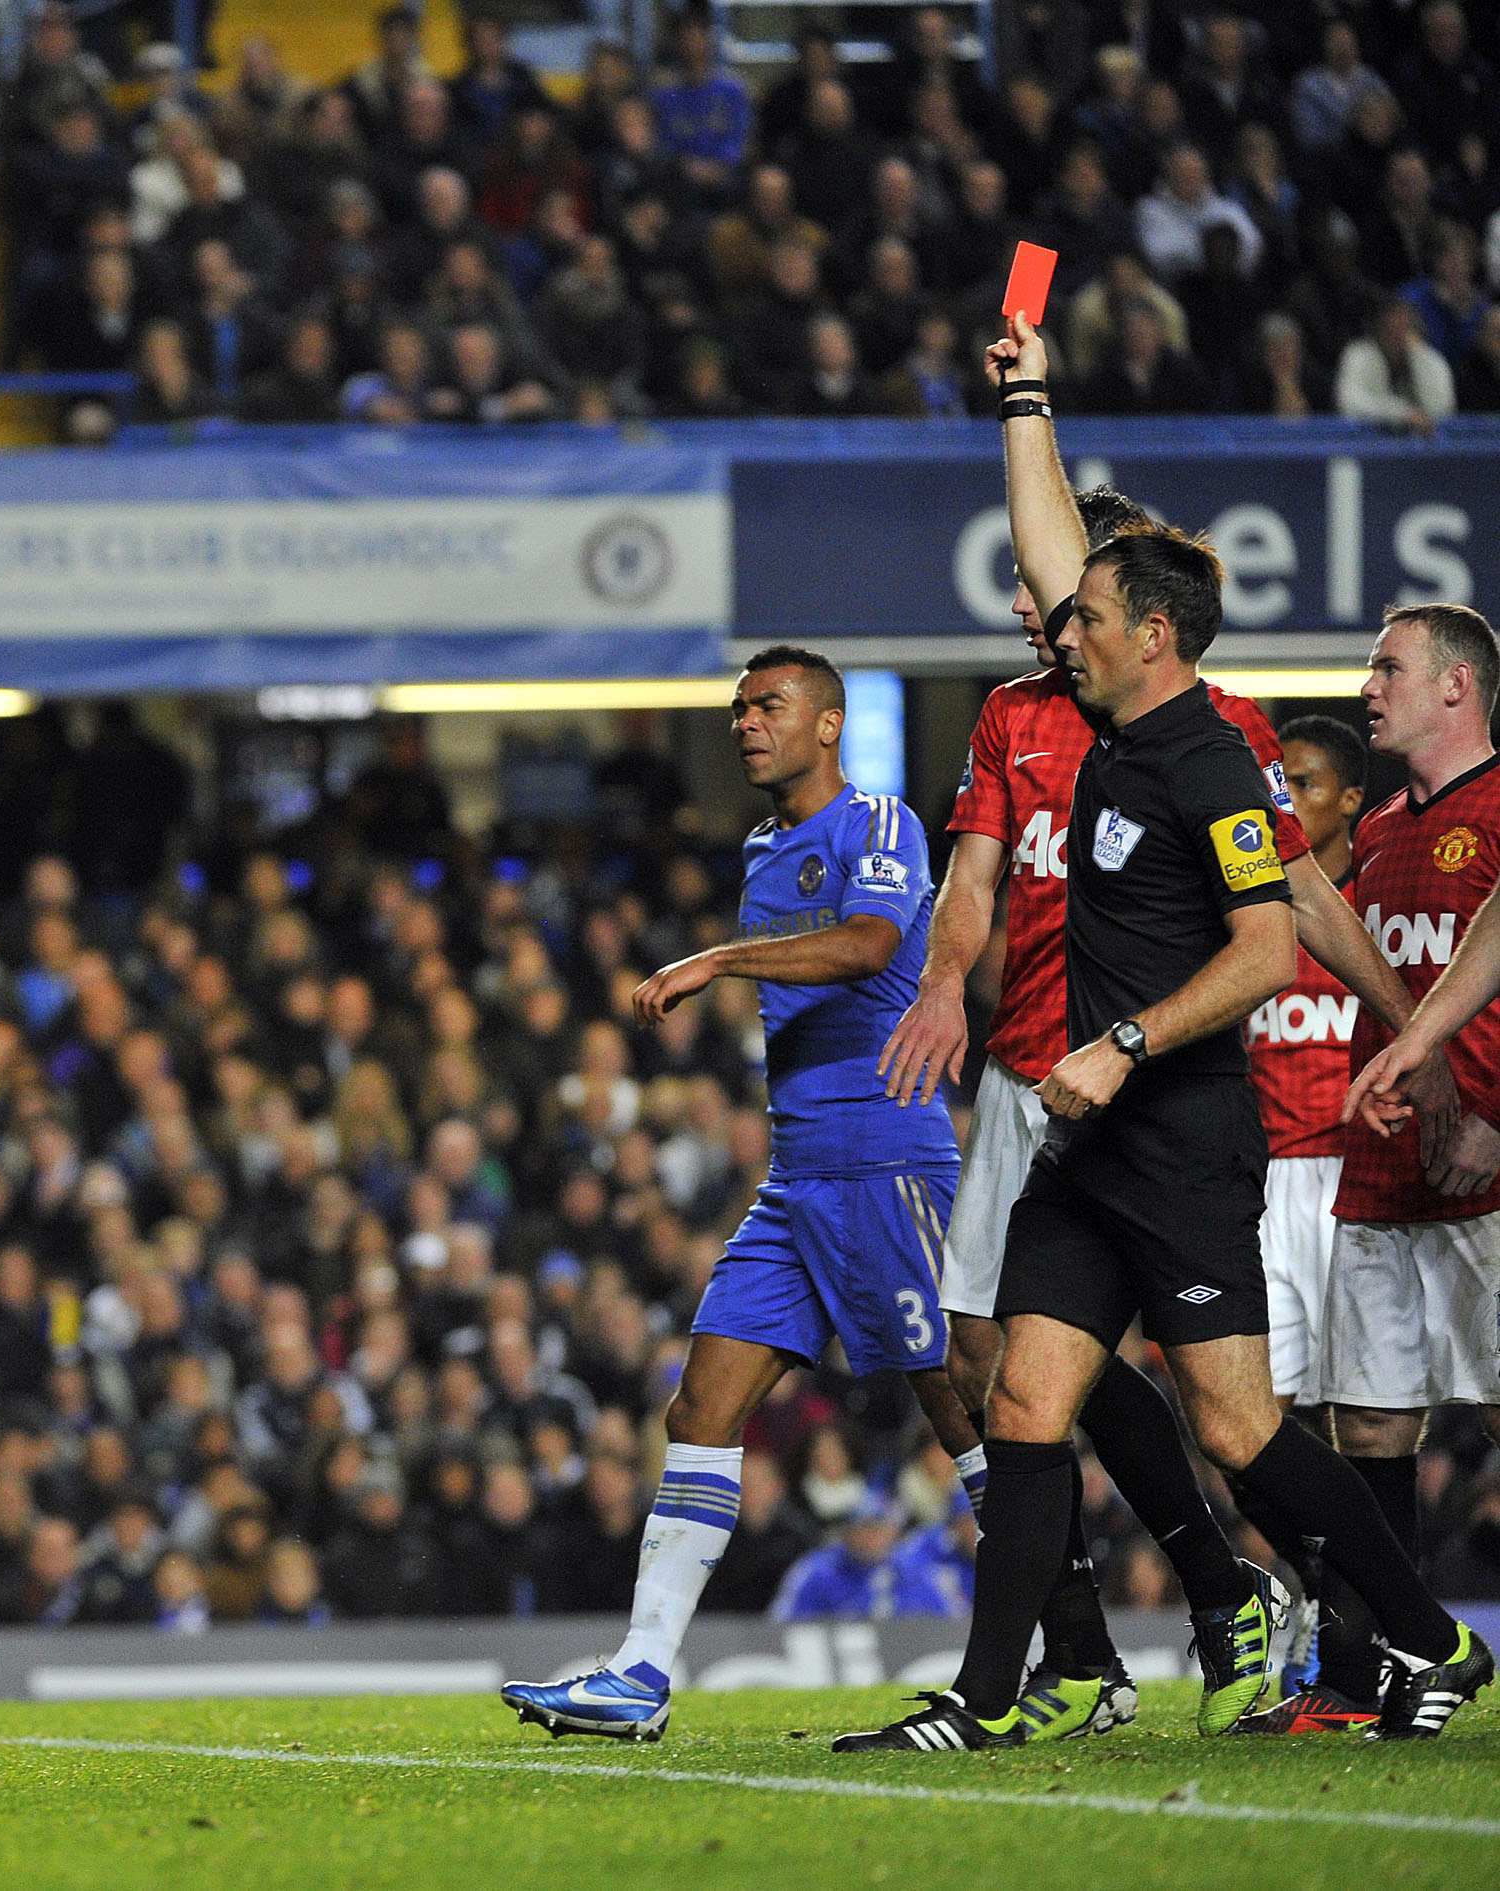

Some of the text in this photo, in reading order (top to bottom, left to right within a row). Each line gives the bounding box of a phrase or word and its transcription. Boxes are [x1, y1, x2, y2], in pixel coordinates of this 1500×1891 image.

[85, 526, 229, 572] CLUB
[1362, 903, 1456, 968] AON
[1248, 995, 1359, 1043] AON
[896, 1288, 934, 1353] 3
